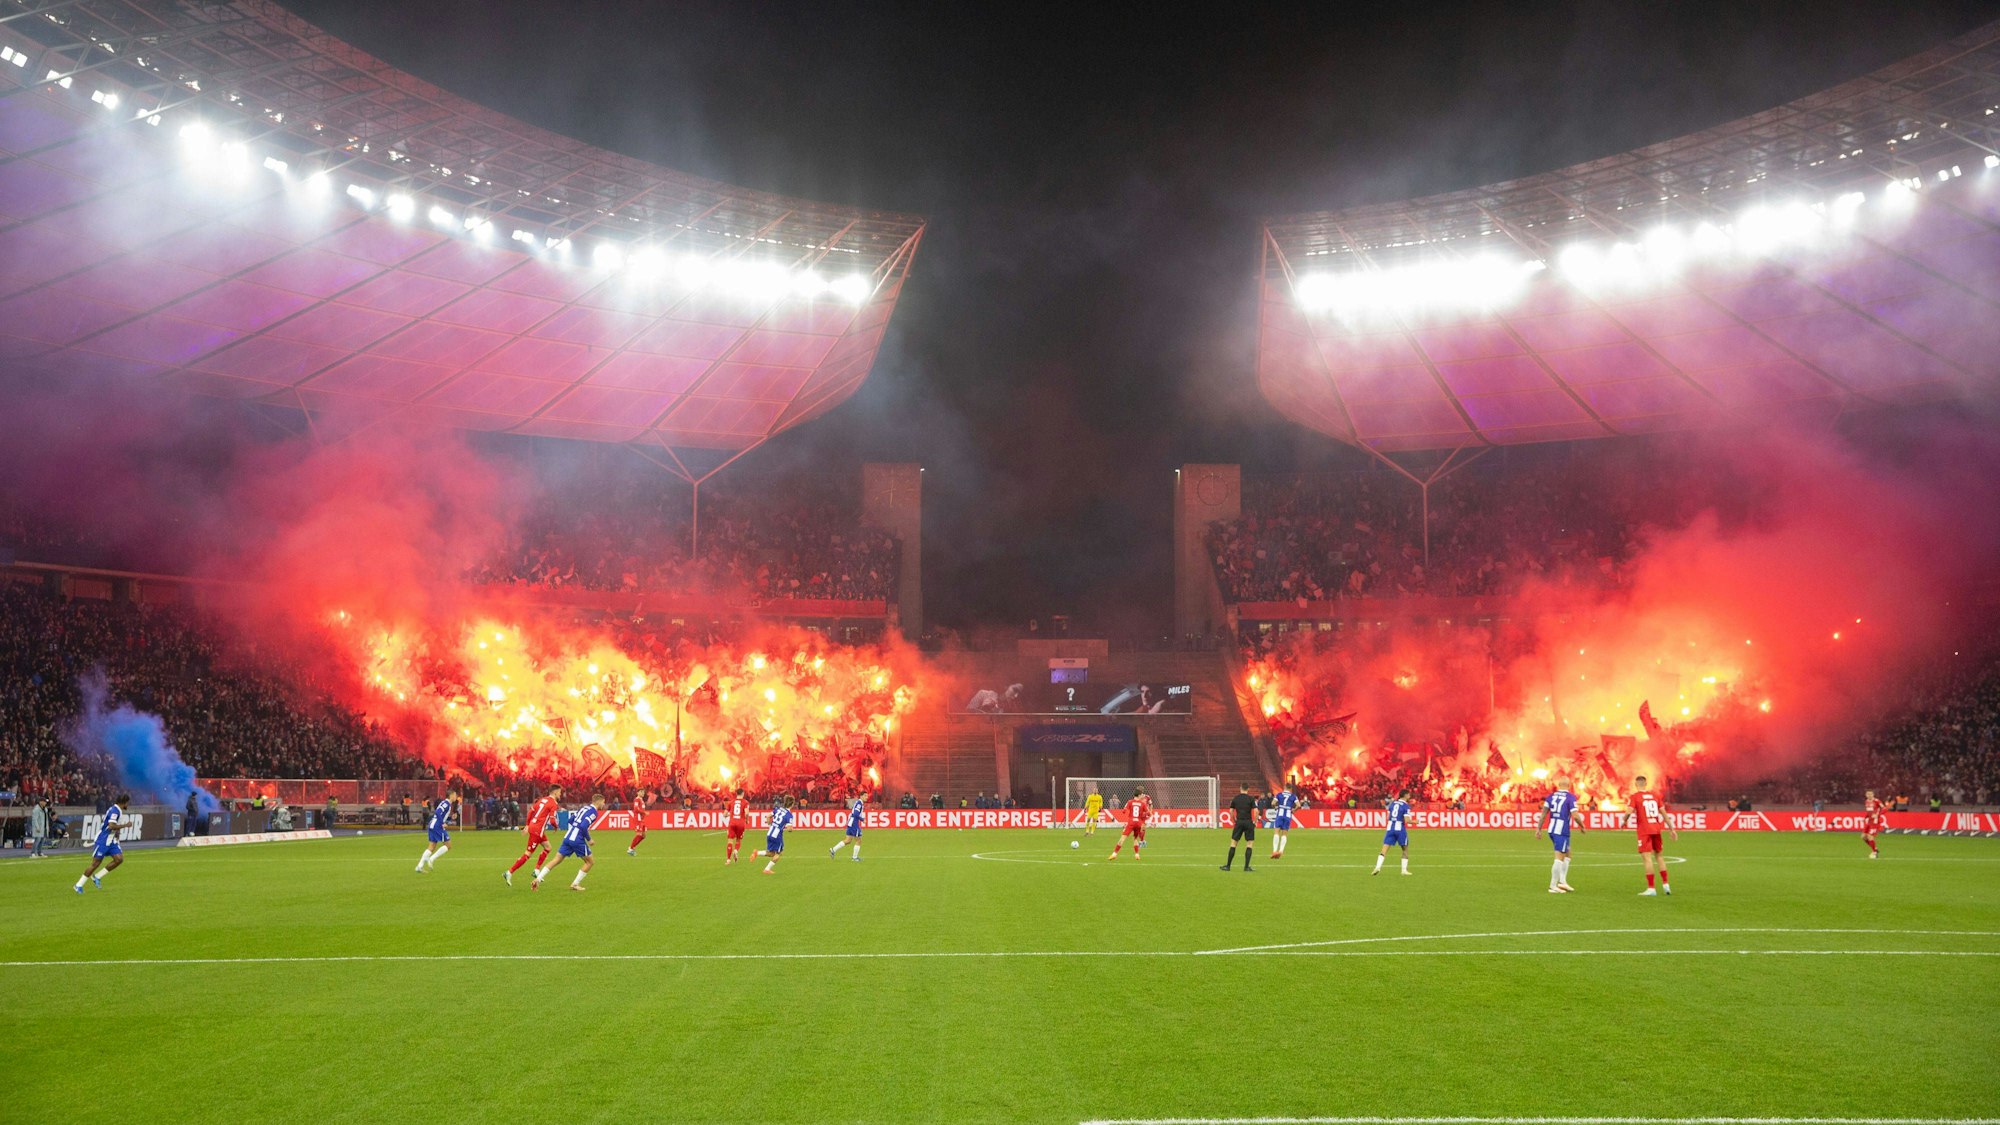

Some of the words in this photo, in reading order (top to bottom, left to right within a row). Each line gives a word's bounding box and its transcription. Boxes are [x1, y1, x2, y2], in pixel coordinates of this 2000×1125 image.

[1168, 685, 1190, 695] MILES
[1283, 795, 1290, 806] 7
[1551, 796, 1567, 813] 37
[733, 803, 741, 815] 6
[1132, 805, 1140, 818] 8
[1391, 804, 1400, 818] 8
[1642, 800, 1658, 817] 19
[608, 813, 630, 828] WTG
[662, 812, 732, 828] LEADIN
[895, 811, 931, 827] FOR
[936, 811, 1053, 827] ENTERPRISE
[772, 809, 786, 824] 33
[1319, 811, 1387, 827] LEADIN
[1738, 814, 1760, 829] WTG
[1792, 814, 1865, 831] wtg.com
